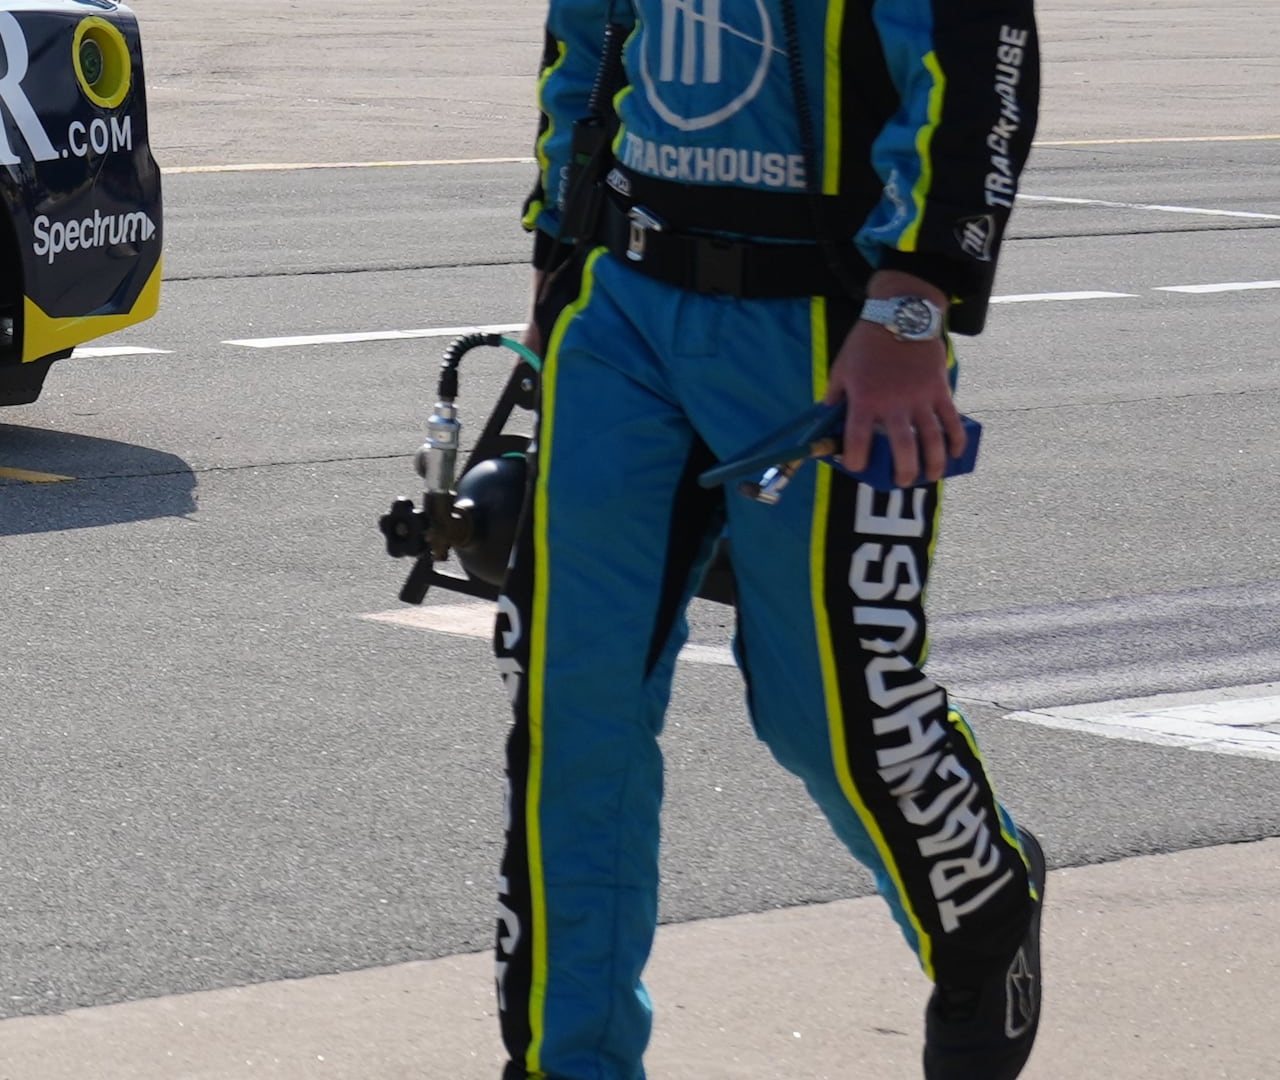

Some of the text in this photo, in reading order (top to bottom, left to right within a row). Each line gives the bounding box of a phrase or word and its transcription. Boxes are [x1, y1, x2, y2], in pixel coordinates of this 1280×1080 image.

[62, 115, 133, 159] .COM
[985, 24, 1030, 208] TRACKHOUSE
[624, 132, 808, 189] TRACKHOUSE
[33, 208, 148, 265] Spectrum
